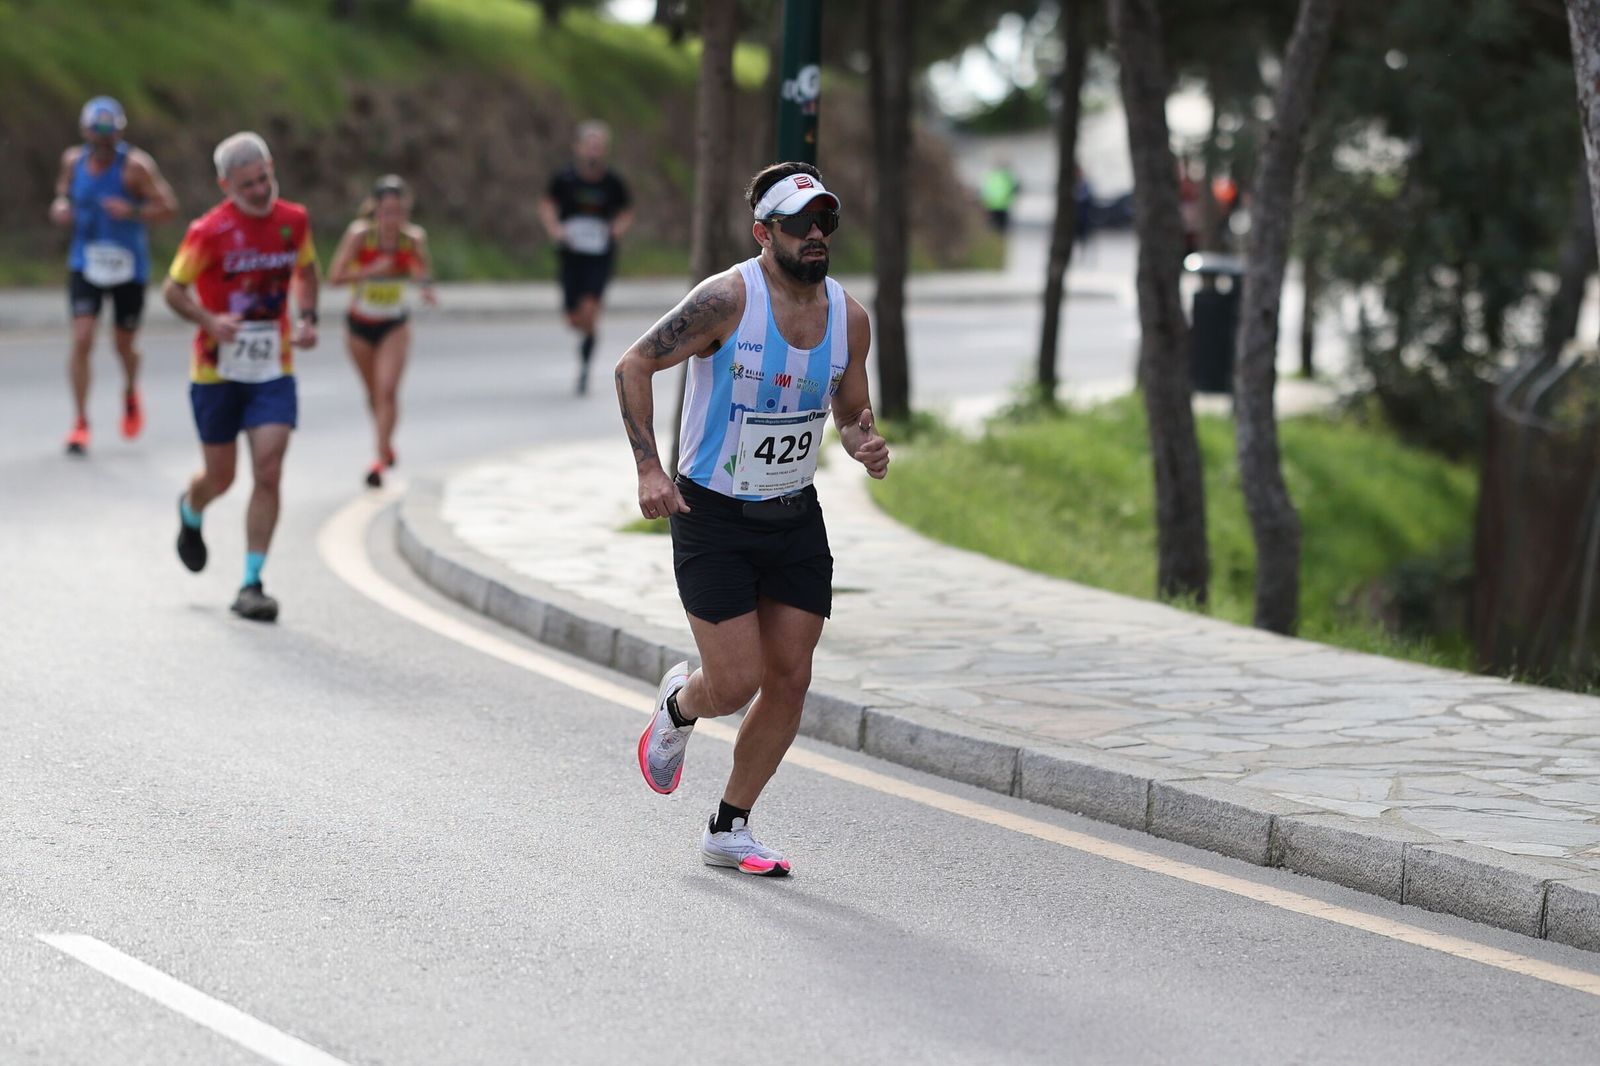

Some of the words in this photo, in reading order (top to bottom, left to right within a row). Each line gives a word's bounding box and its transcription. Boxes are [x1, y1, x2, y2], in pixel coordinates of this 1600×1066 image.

[234, 339, 274, 360] 762
[737, 341, 763, 352] vive
[754, 431, 812, 464] 429
